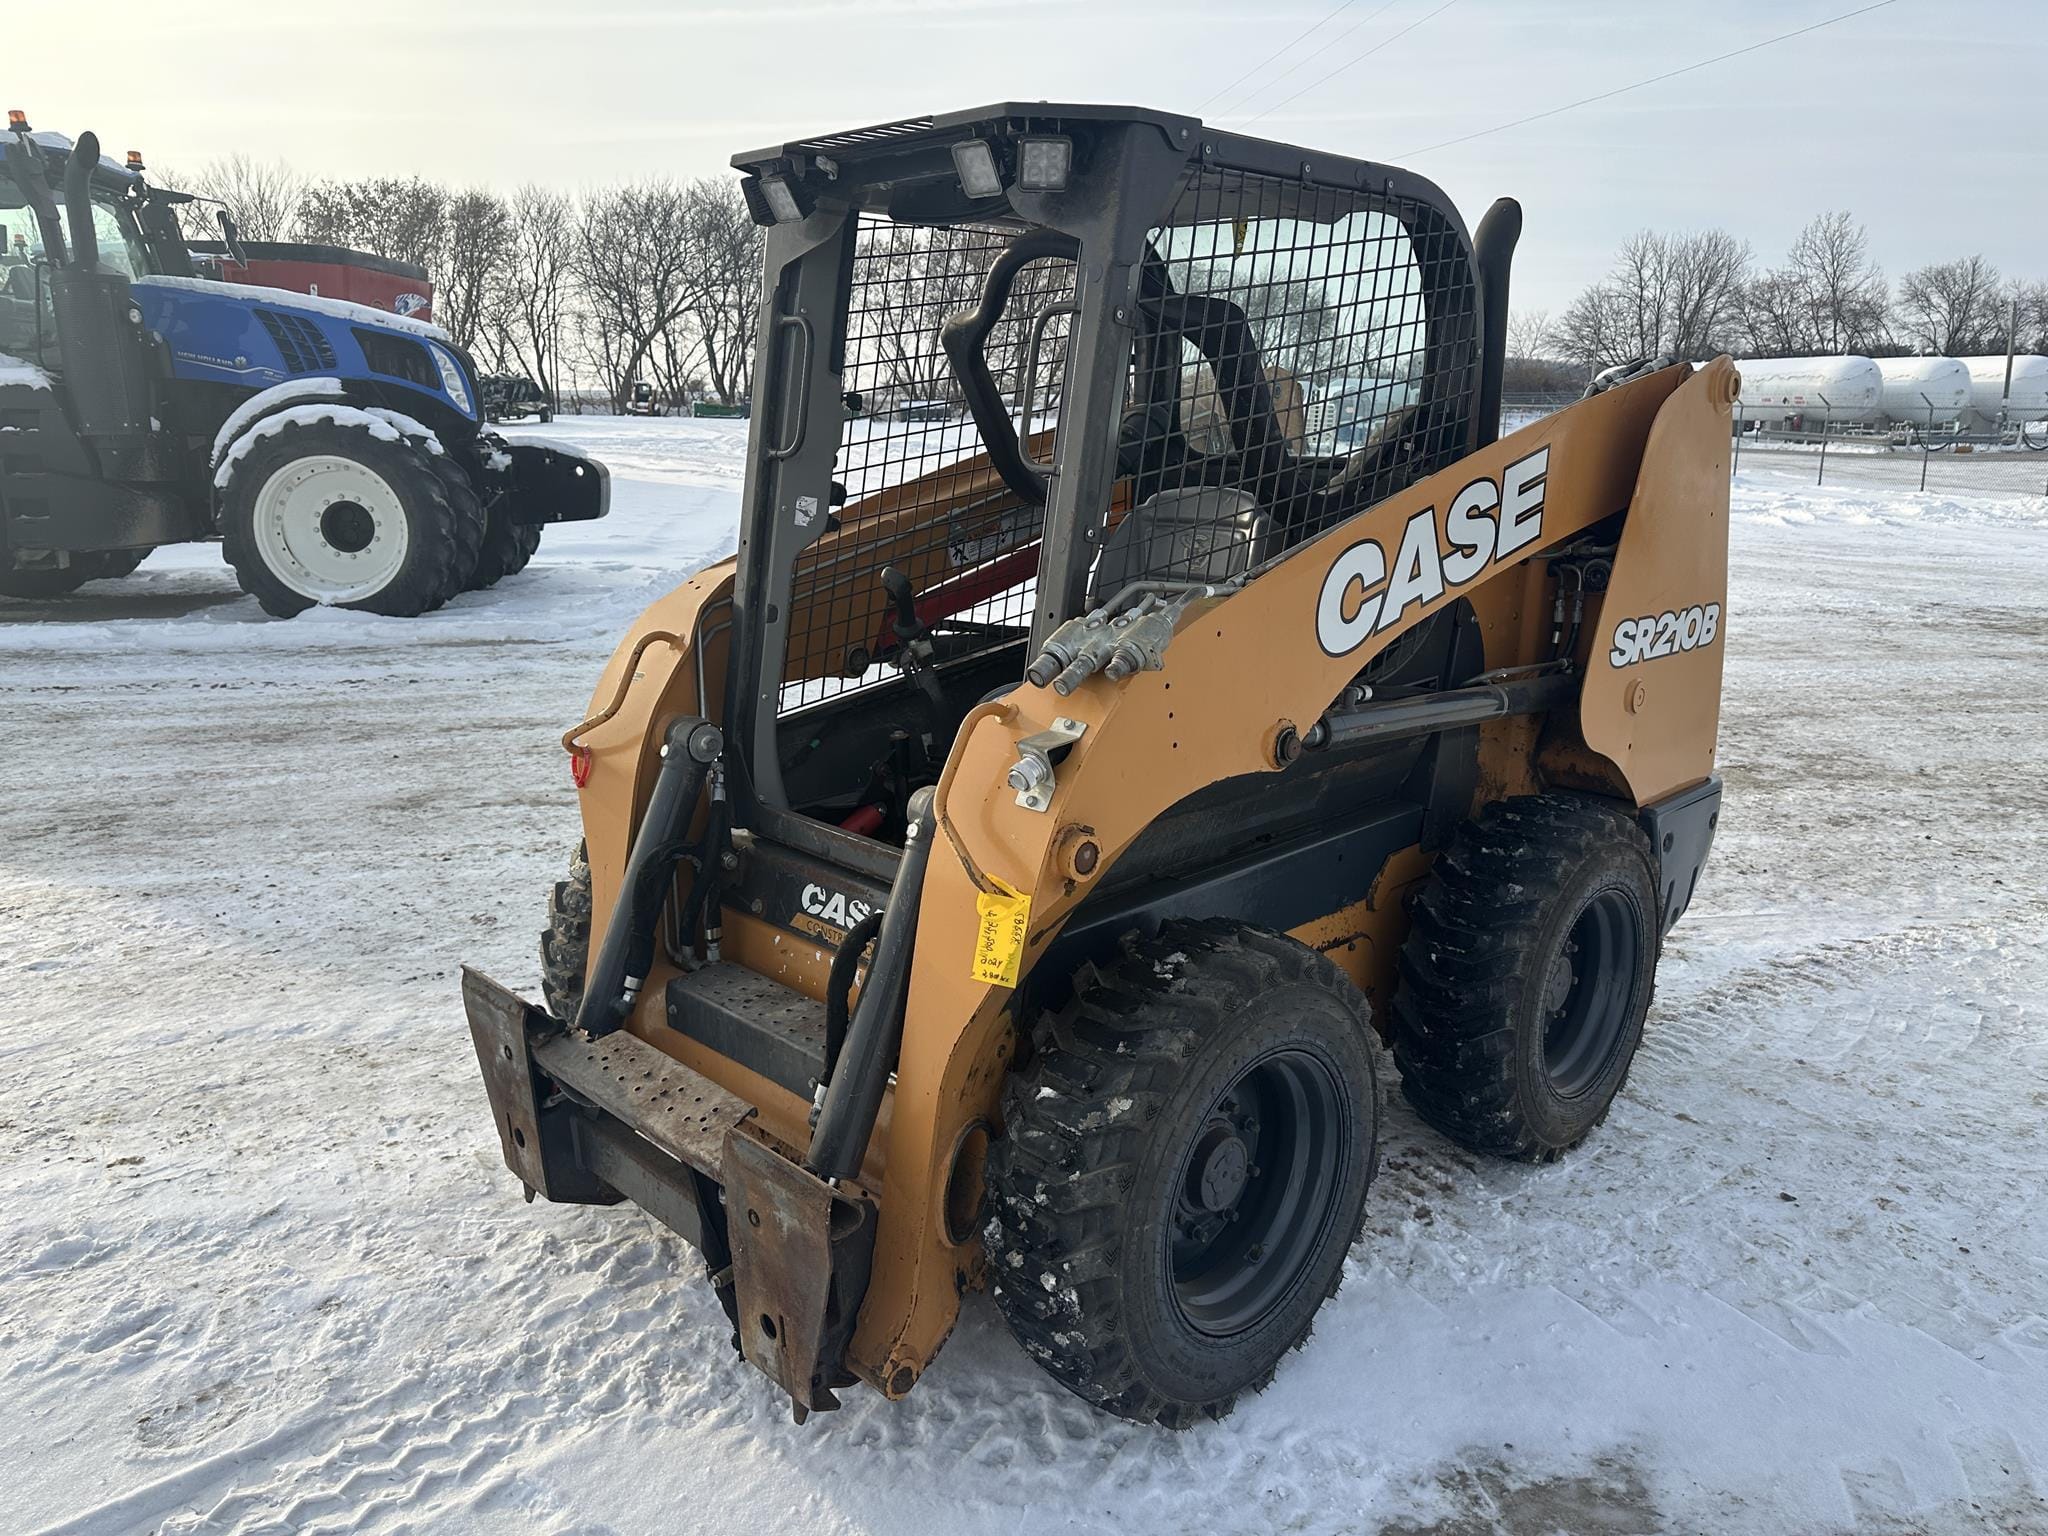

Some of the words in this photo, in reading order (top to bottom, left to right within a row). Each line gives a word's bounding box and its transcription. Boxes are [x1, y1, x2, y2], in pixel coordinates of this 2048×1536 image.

[1316, 444, 1550, 657] CASE
[1609, 602, 1720, 669] SR210B
[802, 882, 885, 930] CAS
